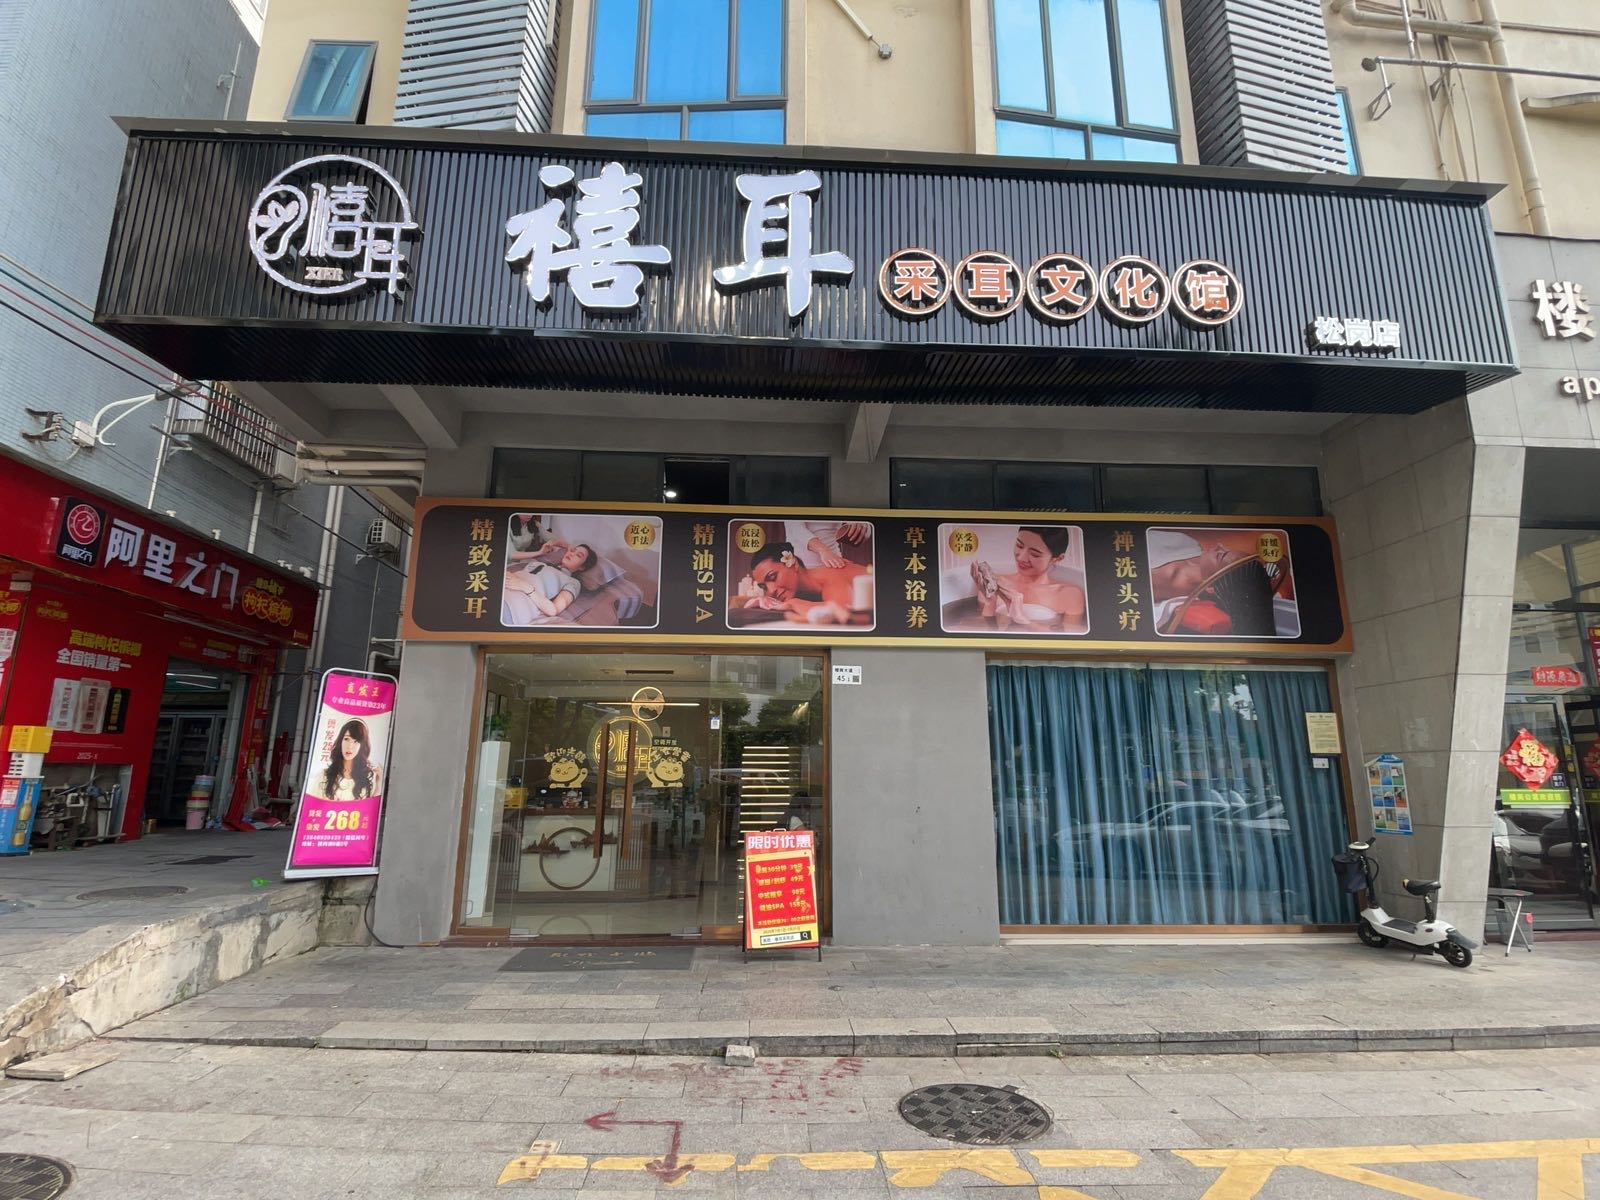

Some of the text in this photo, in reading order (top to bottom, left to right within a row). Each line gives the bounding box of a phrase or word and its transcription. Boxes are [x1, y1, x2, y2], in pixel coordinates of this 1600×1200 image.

[505, 161, 855, 317] 禧耳
[890, 258, 1231, 314] 采耳文化馆
[1532, 279, 1598, 338] 楼
[1314, 316, 1401, 348] 松岗店
[741, 527, 760, 538] 沉浸
[741, 538, 760, 548] 放松
[104, 517, 240, 612] 阿里之门
[463, 517, 494, 620] 精致采耳
[691, 523, 715, 623] 精油SPA
[903, 526, 928, 629] 草本浴养
[1112, 529, 1142, 632] 禅洗头疗
[56, 647, 132, 672] 全国销量第一
[323, 809, 361, 830] 268
[747, 834, 812, 850] 限时优惠
